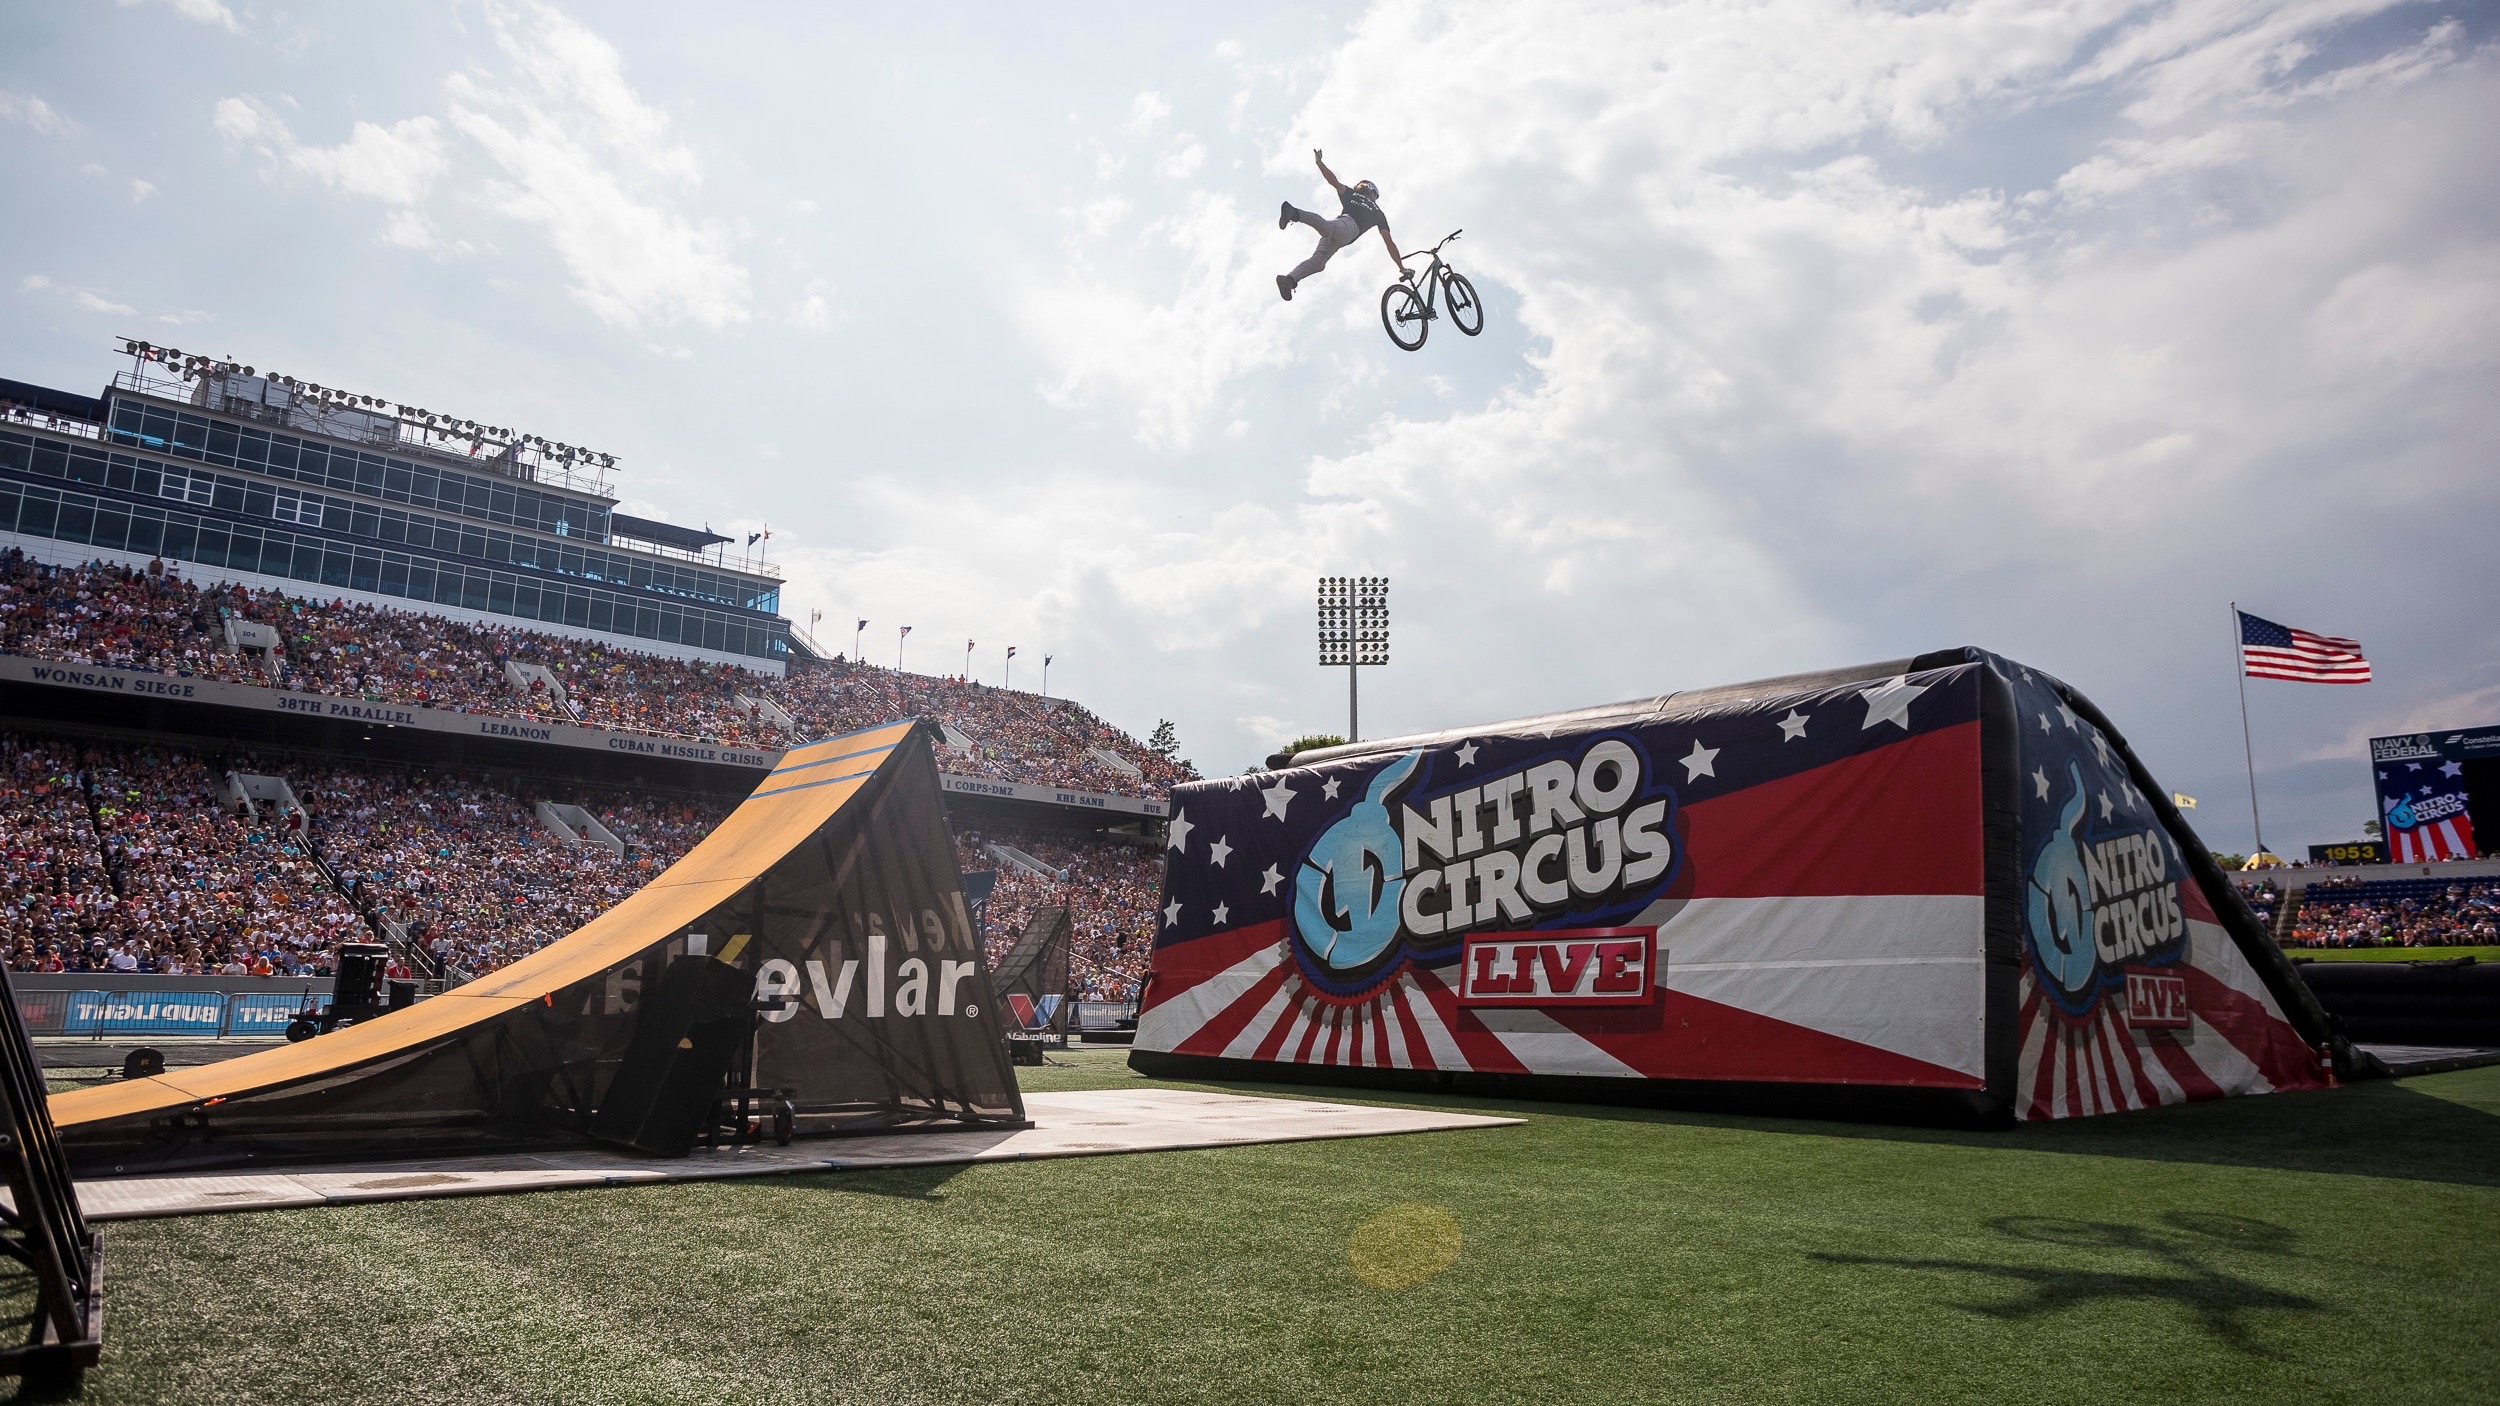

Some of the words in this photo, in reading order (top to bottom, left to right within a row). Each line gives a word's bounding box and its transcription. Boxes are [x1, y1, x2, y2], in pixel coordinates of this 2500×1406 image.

[242, 630, 256, 638] 104
[32, 666, 125, 690] WONSAN
[134, 680, 195, 697] SIEGE
[277, 696, 322, 714] 38TH
[329, 703, 415, 725] PARALLEL
[480, 722, 551, 741] LEBANON
[609, 737, 655, 753] CUBAN
[660, 744, 716, 761] MISSILE
[721, 752, 764, 767] CRISIS
[2372, 736, 2412, 751] NAVY
[2373, 744, 2437, 760] FEDERAL
[955, 781, 1014, 796] CORPS-DMZ
[1056, 793, 1076, 805] KHE
[1079, 796, 1105, 808] SANH
[1143, 803, 1161, 814] HUE
[1402, 740, 1641, 874] NITRO
[2410, 793, 2456, 818] NITRO
[2415, 802, 2464, 823] CIRCUS
[2324, 845, 2375, 861] 1953
[1402, 799, 1672, 936] CIRCUS
[2082, 829, 2167, 904] NITRO
[2093, 882, 2184, 964] CIRCUS
[1470, 941, 1643, 994] LIVE
[2128, 975, 2187, 1018] LIVE
[1006, 1032, 1061, 1043] Valvoline
